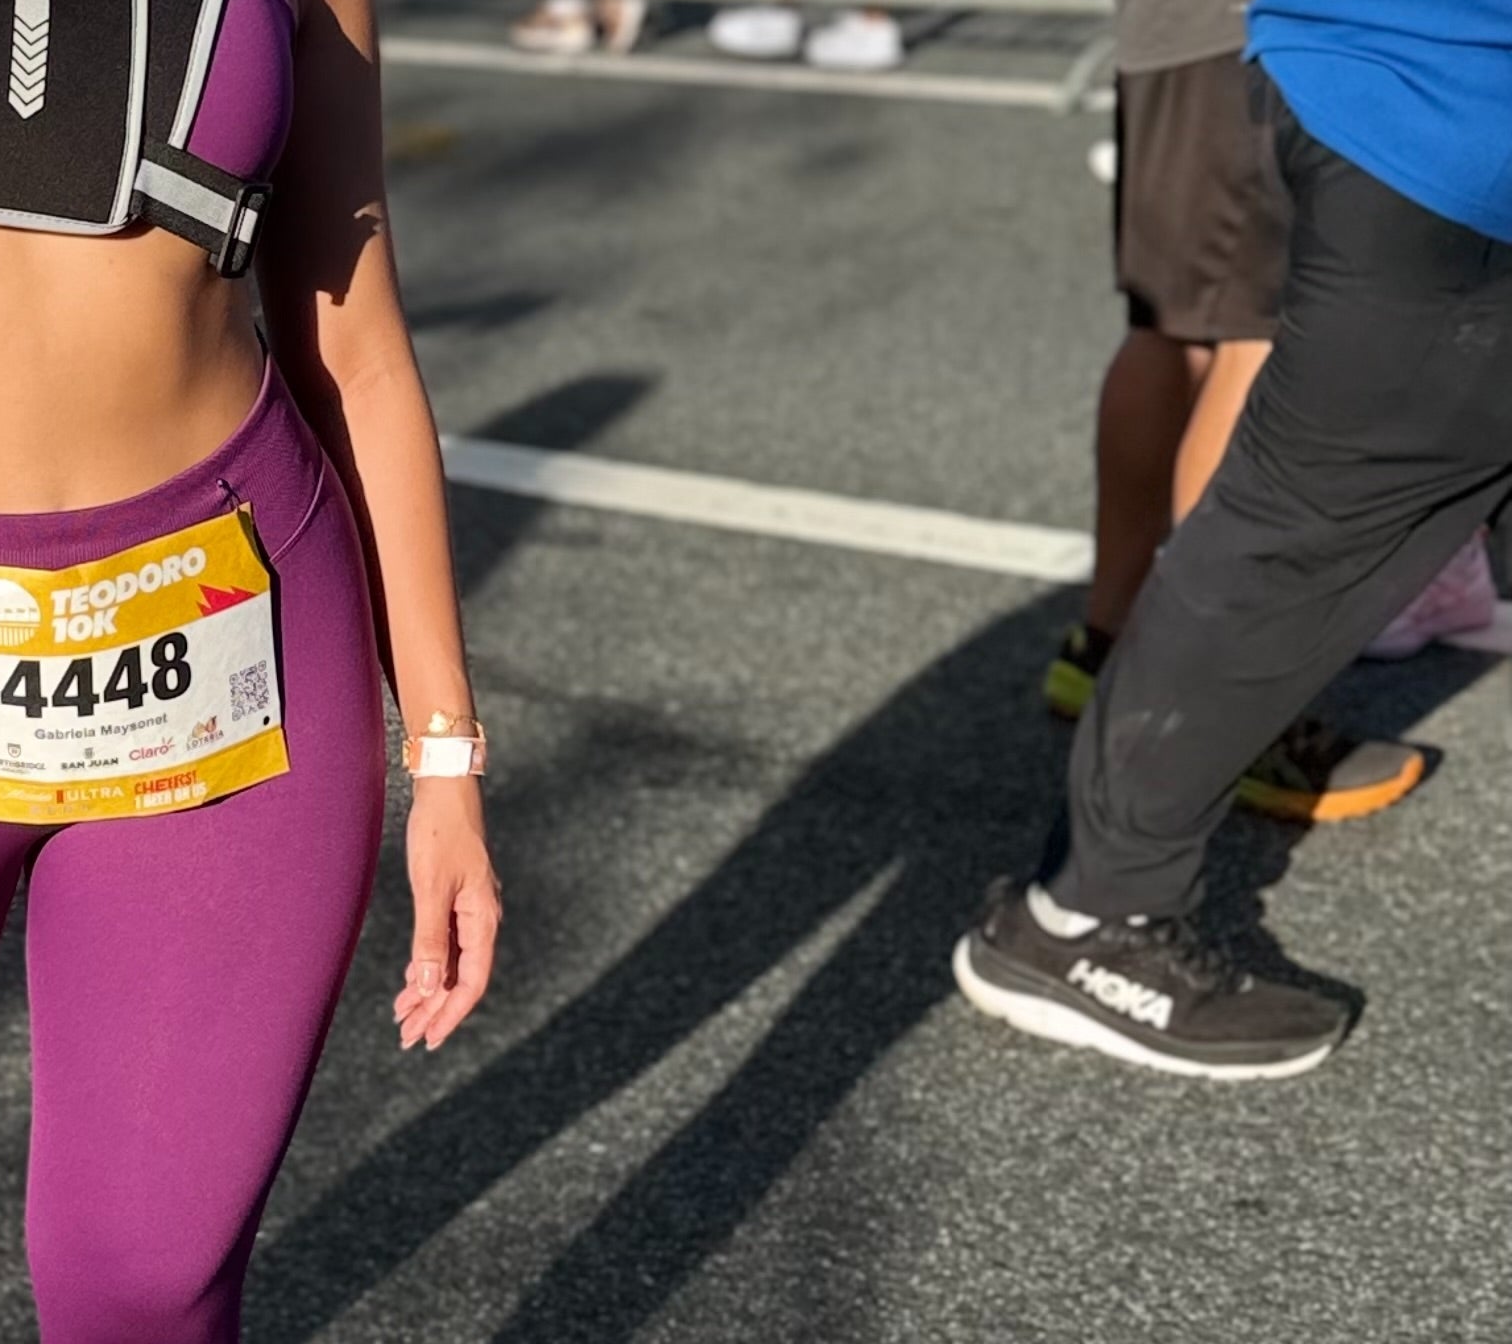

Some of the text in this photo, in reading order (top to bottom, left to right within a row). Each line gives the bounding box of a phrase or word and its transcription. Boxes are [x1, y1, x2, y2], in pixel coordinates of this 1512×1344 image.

[50, 546, 207, 616] TEODORO
[51, 606, 120, 644] 10K
[0, 631, 192, 719] 4448
[34, 713, 168, 741] Gabriela Maysonet
[61, 757, 120, 771] SAN JUAN
[128, 742, 171, 762] Claro
[66, 786, 125, 802] ULTRA
[1066, 958, 1174, 1031] HOKA
